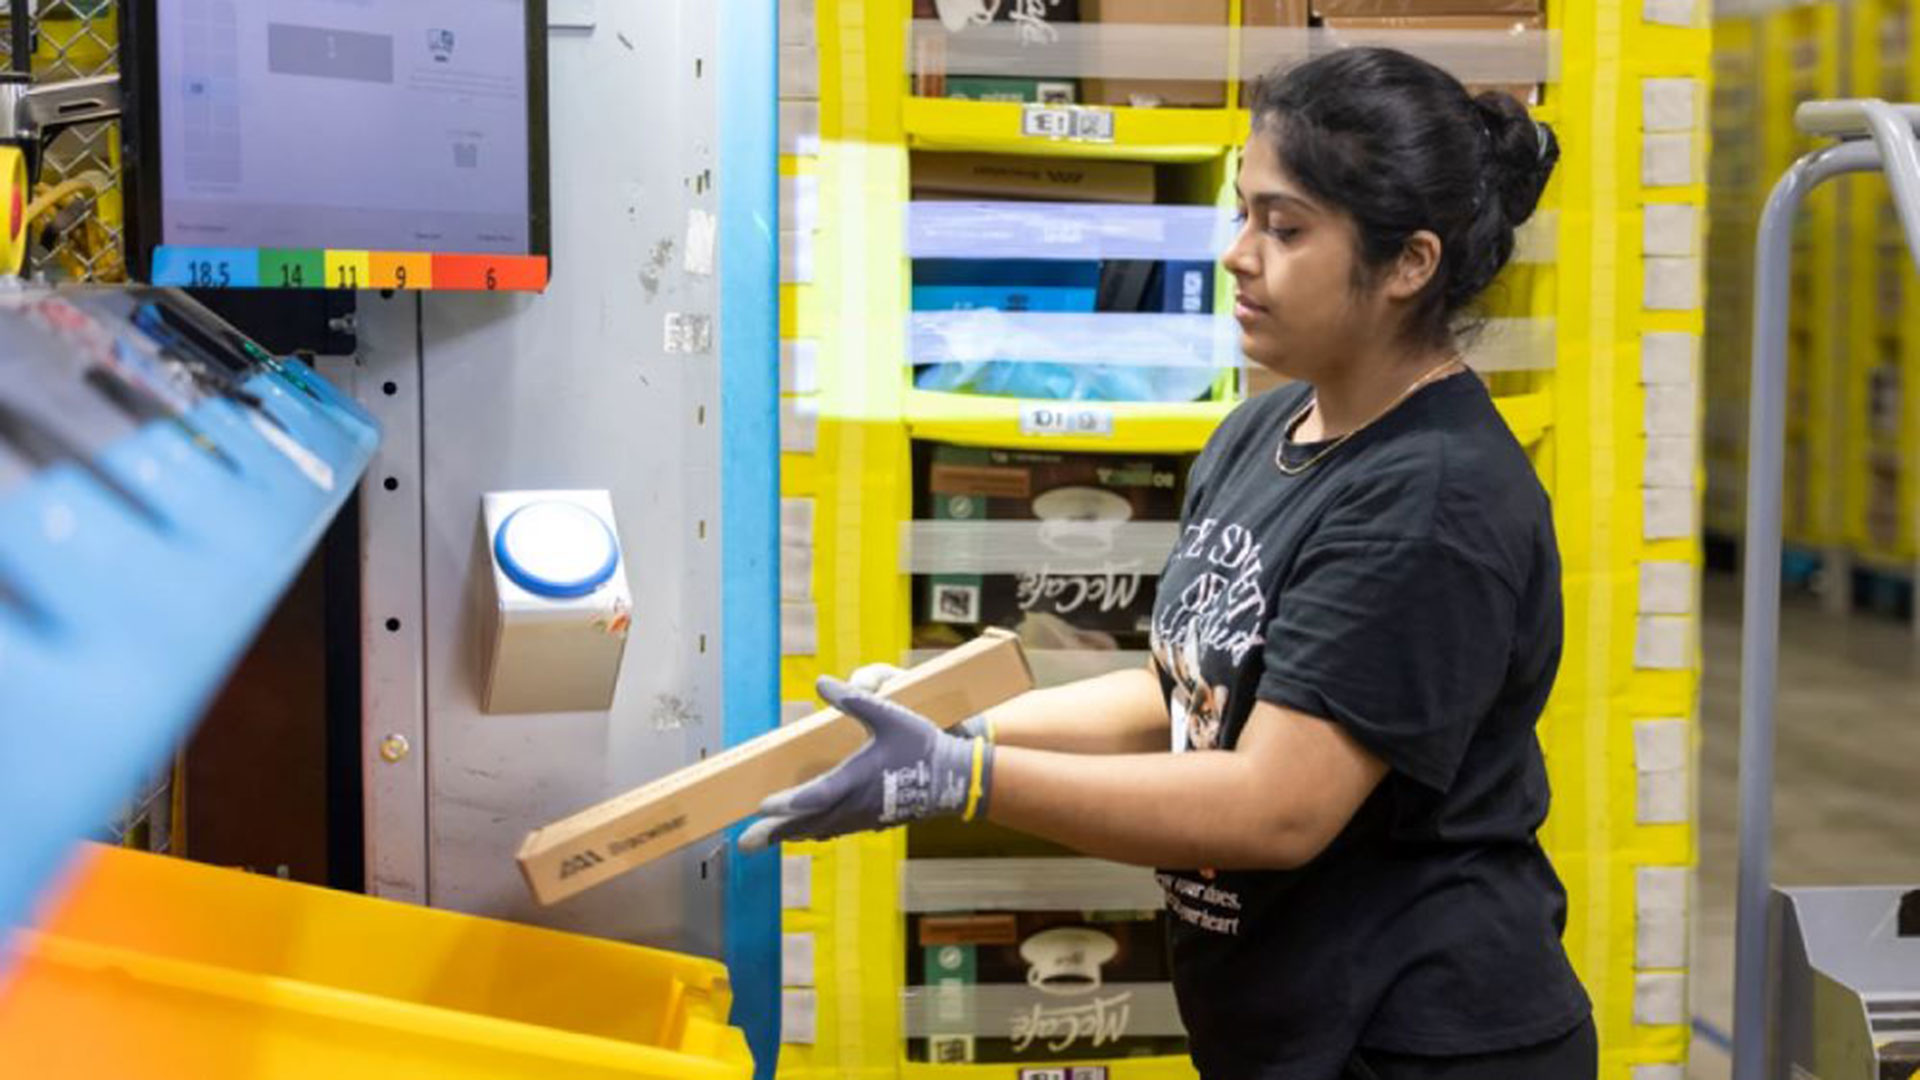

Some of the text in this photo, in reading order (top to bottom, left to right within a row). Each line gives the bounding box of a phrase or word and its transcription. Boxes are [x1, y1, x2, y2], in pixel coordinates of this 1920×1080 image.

[188, 260, 497, 289] 18.5 14 11 9 6
[1010, 989, 1131, 1052] McCafé
